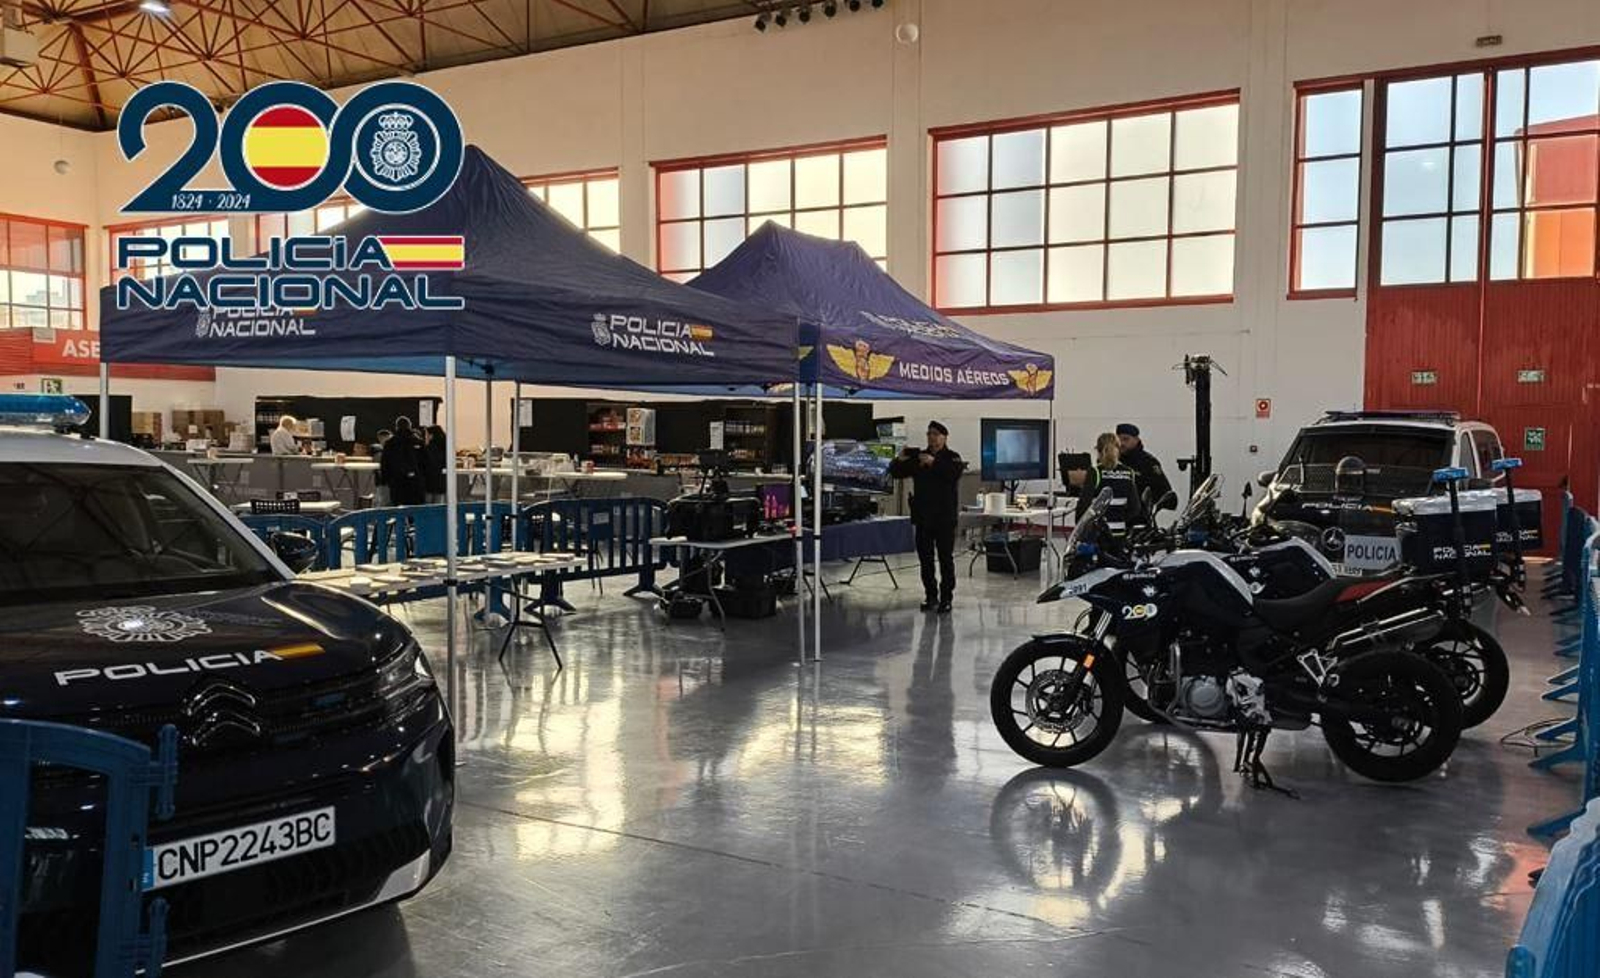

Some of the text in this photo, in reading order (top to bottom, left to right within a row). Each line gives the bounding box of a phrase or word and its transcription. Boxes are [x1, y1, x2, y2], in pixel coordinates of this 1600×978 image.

[208, 318, 317, 338] NACIONAL
[612, 332, 715, 357] NACIONAL
[899, 361, 1010, 386] MEDIOS AÉREOS
[54, 649, 284, 687] POLICIA
[158, 813, 331, 880] CNP2243BC
